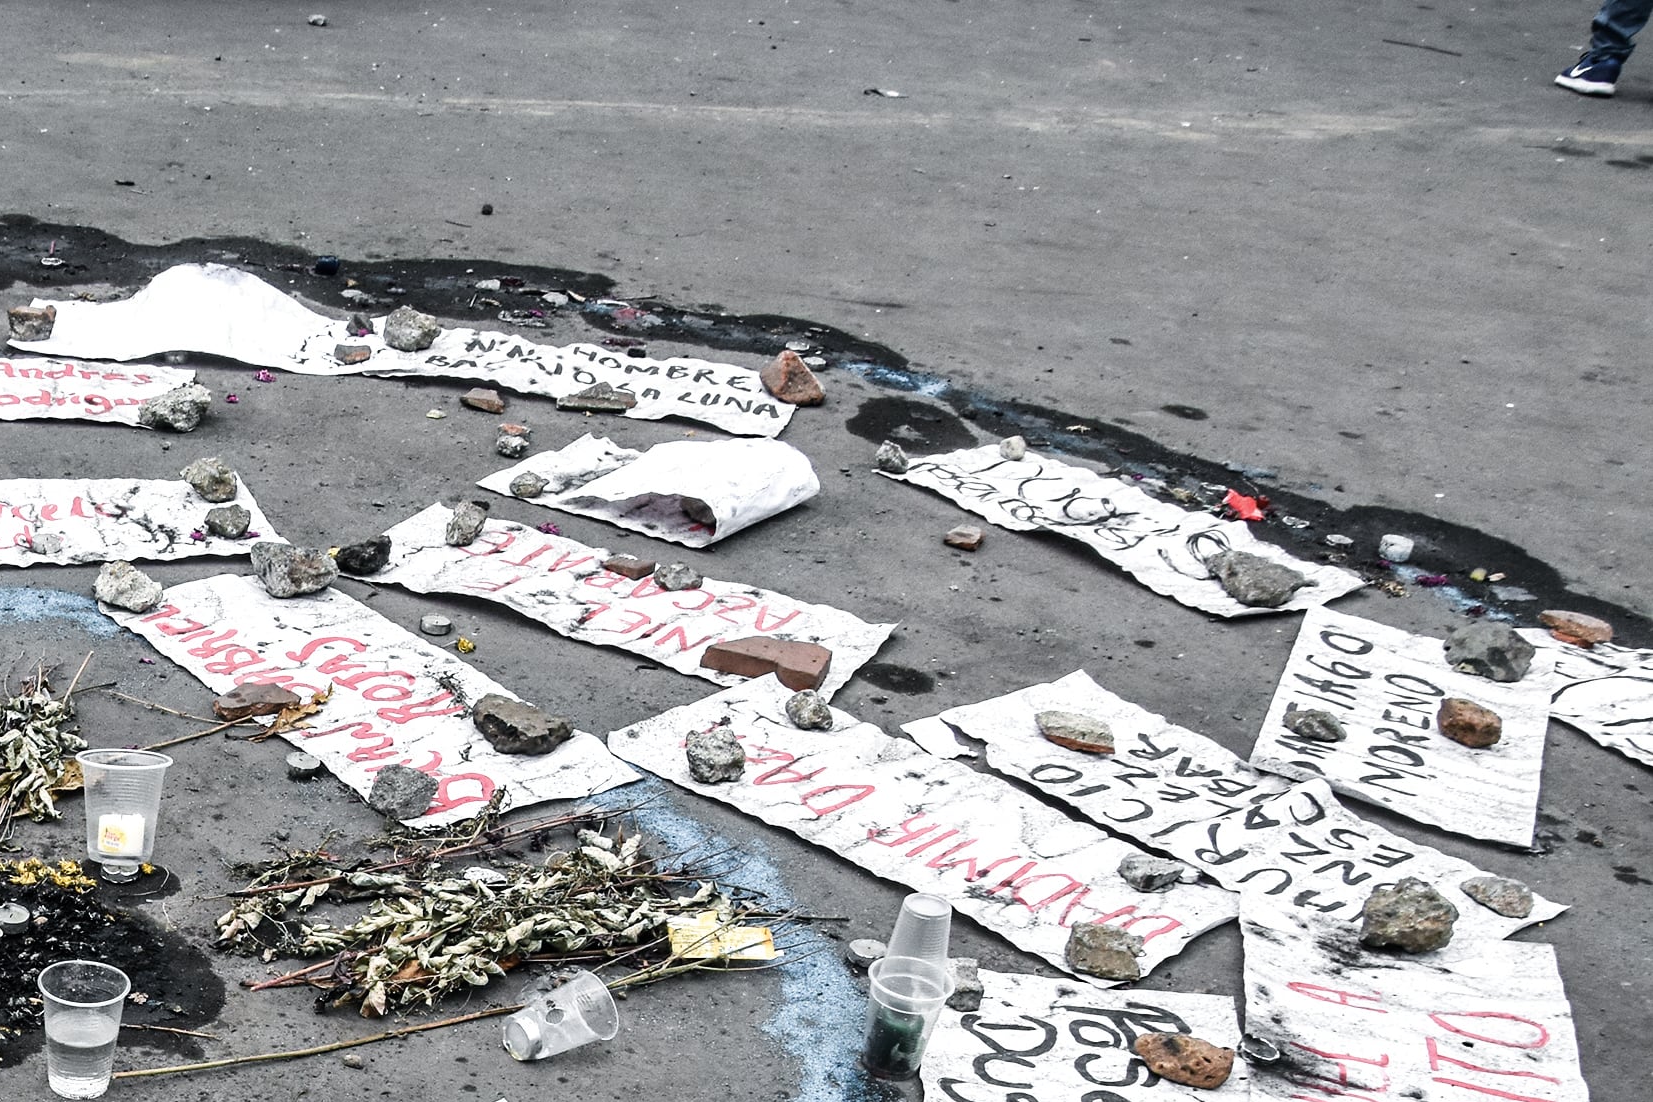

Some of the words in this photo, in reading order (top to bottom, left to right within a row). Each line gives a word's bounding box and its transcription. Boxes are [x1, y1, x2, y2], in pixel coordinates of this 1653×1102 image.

[678, 392, 780, 419] LUNA
[578, 602, 714, 653] NIEL
[1358, 672, 1445, 794] MORENO
[1030, 762, 1356, 918] AURICIO
